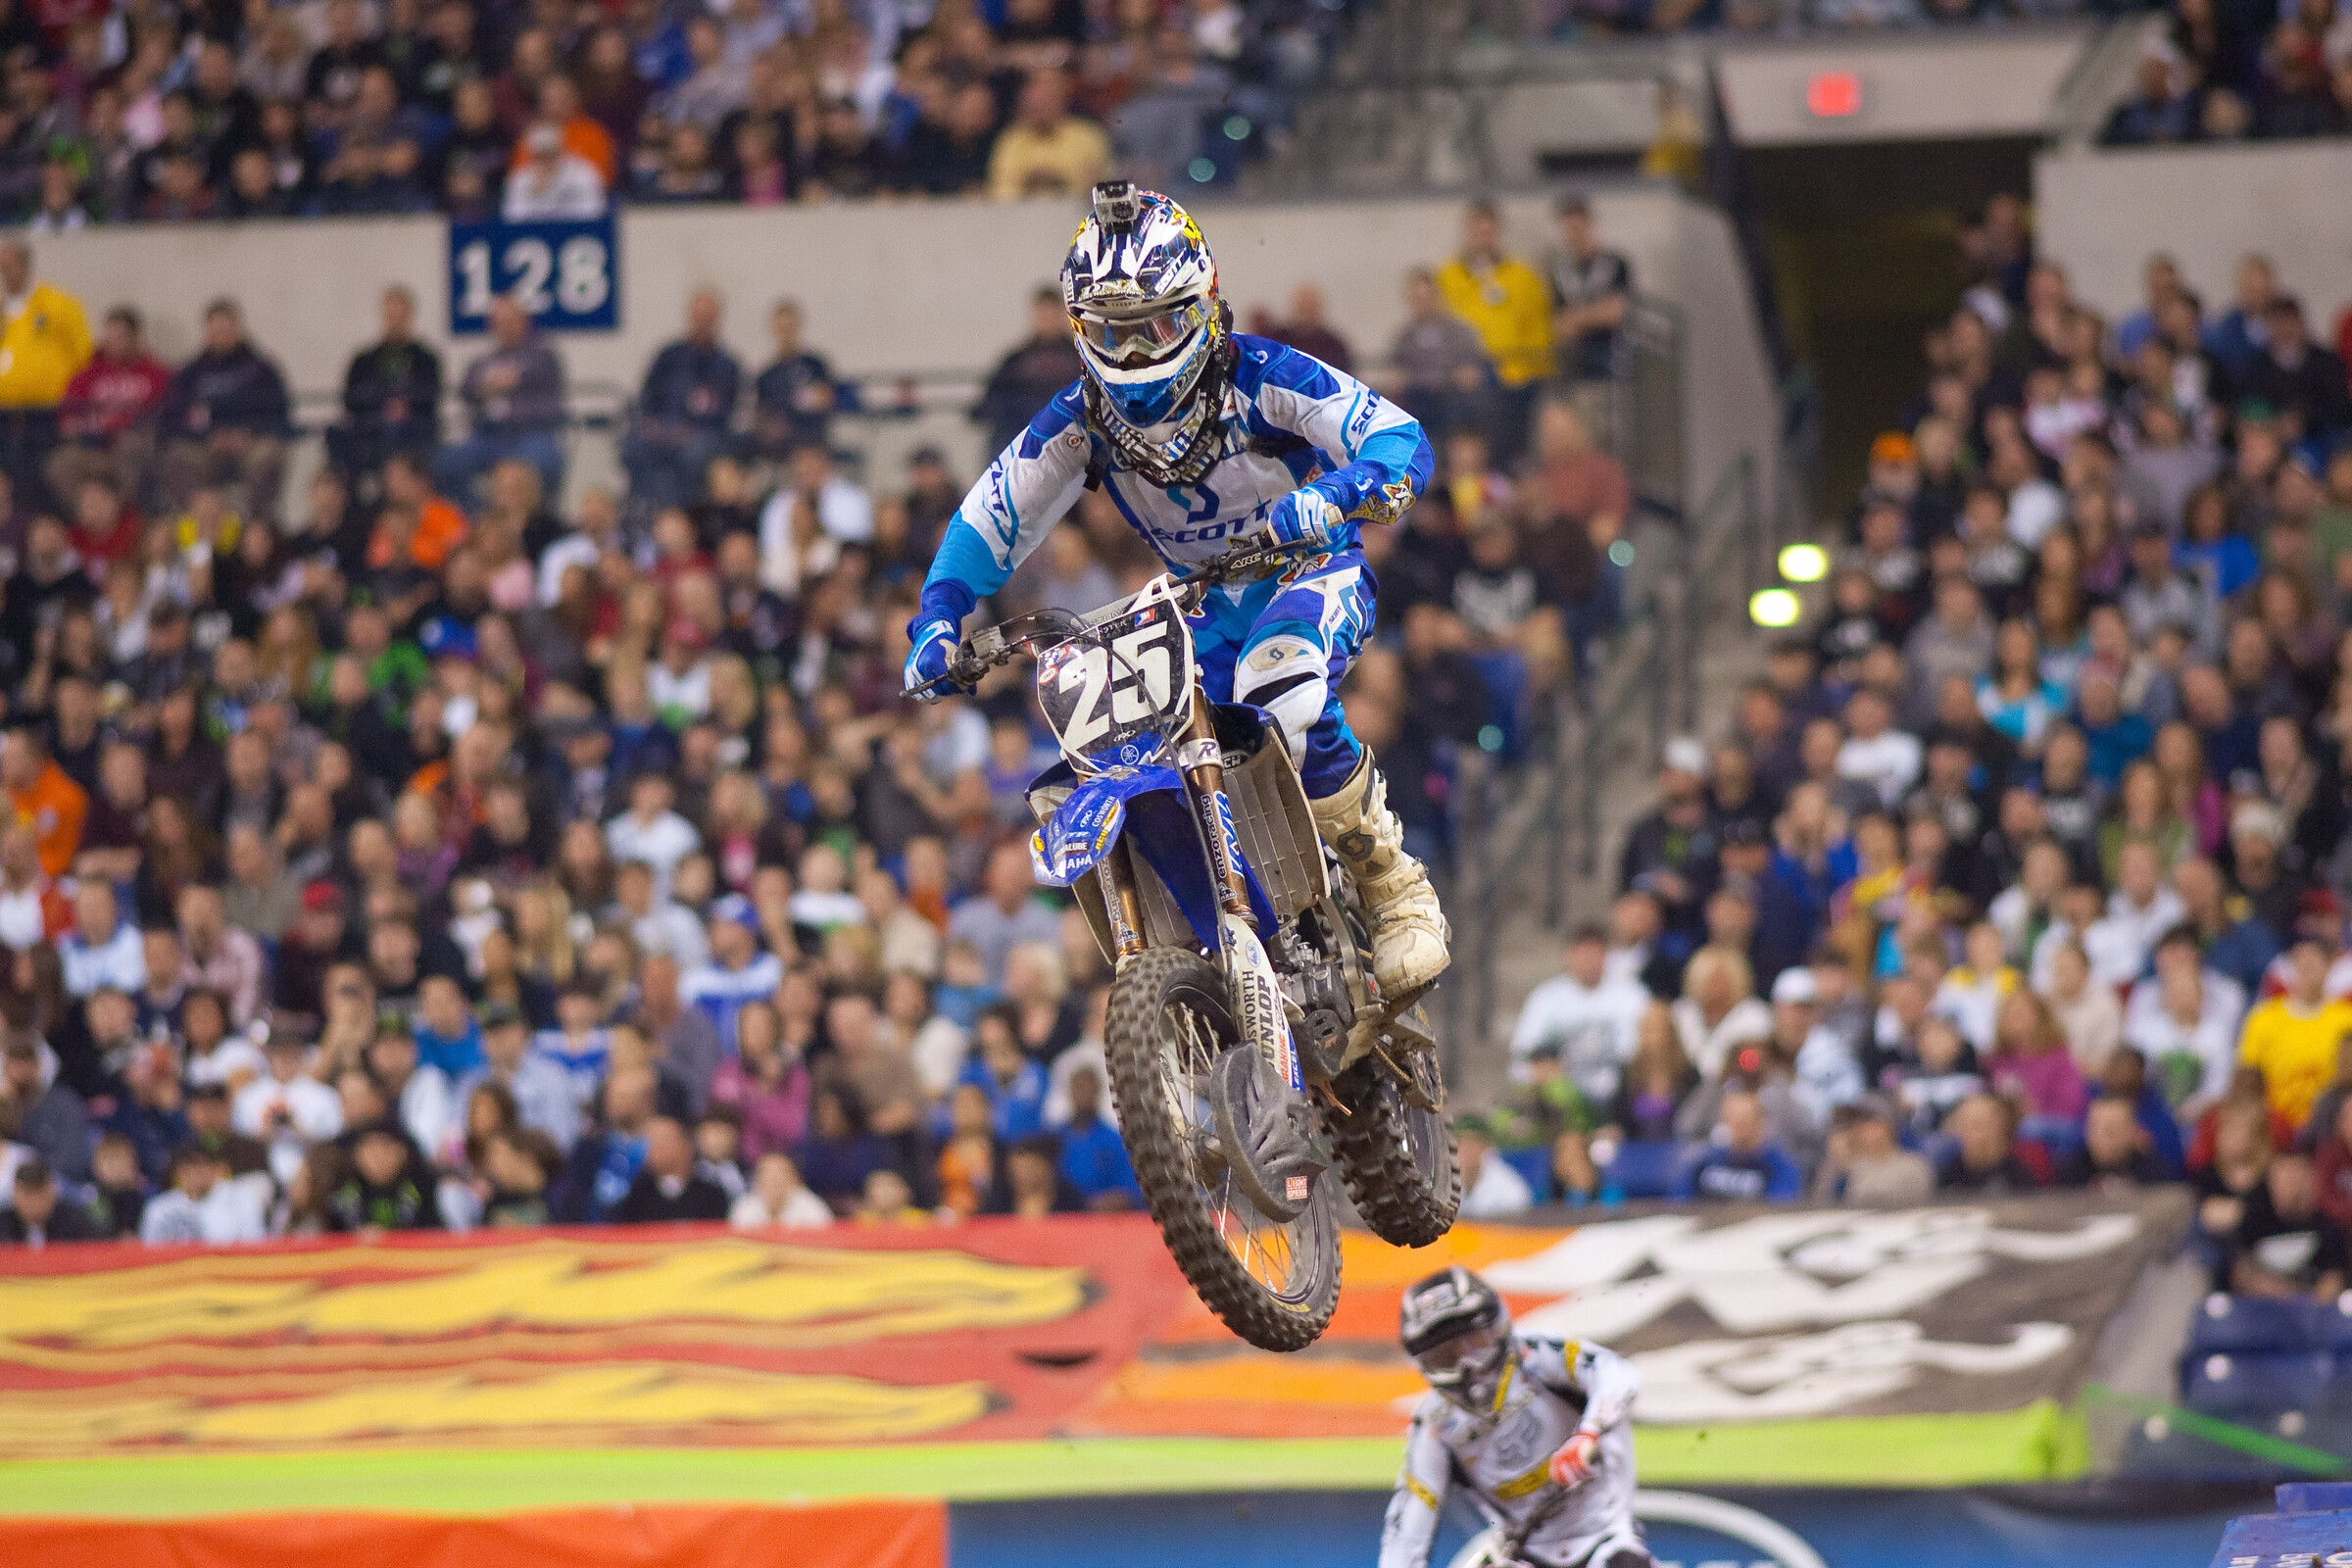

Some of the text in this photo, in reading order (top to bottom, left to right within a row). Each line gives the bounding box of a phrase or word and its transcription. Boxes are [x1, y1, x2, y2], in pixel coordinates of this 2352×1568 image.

[458, 238, 609, 315] 128
[1151, 498, 1272, 543] SCOTT
[1230, 553, 1262, 569] ARC
[1058, 620, 1172, 751] 25
[1092, 796, 1115, 827] COSWORTH
[1257, 975, 1275, 1063] UNLOP
[1287, 1177, 1306, 1188] LIGHT
[1287, 1188, 1306, 1199] SPEED
